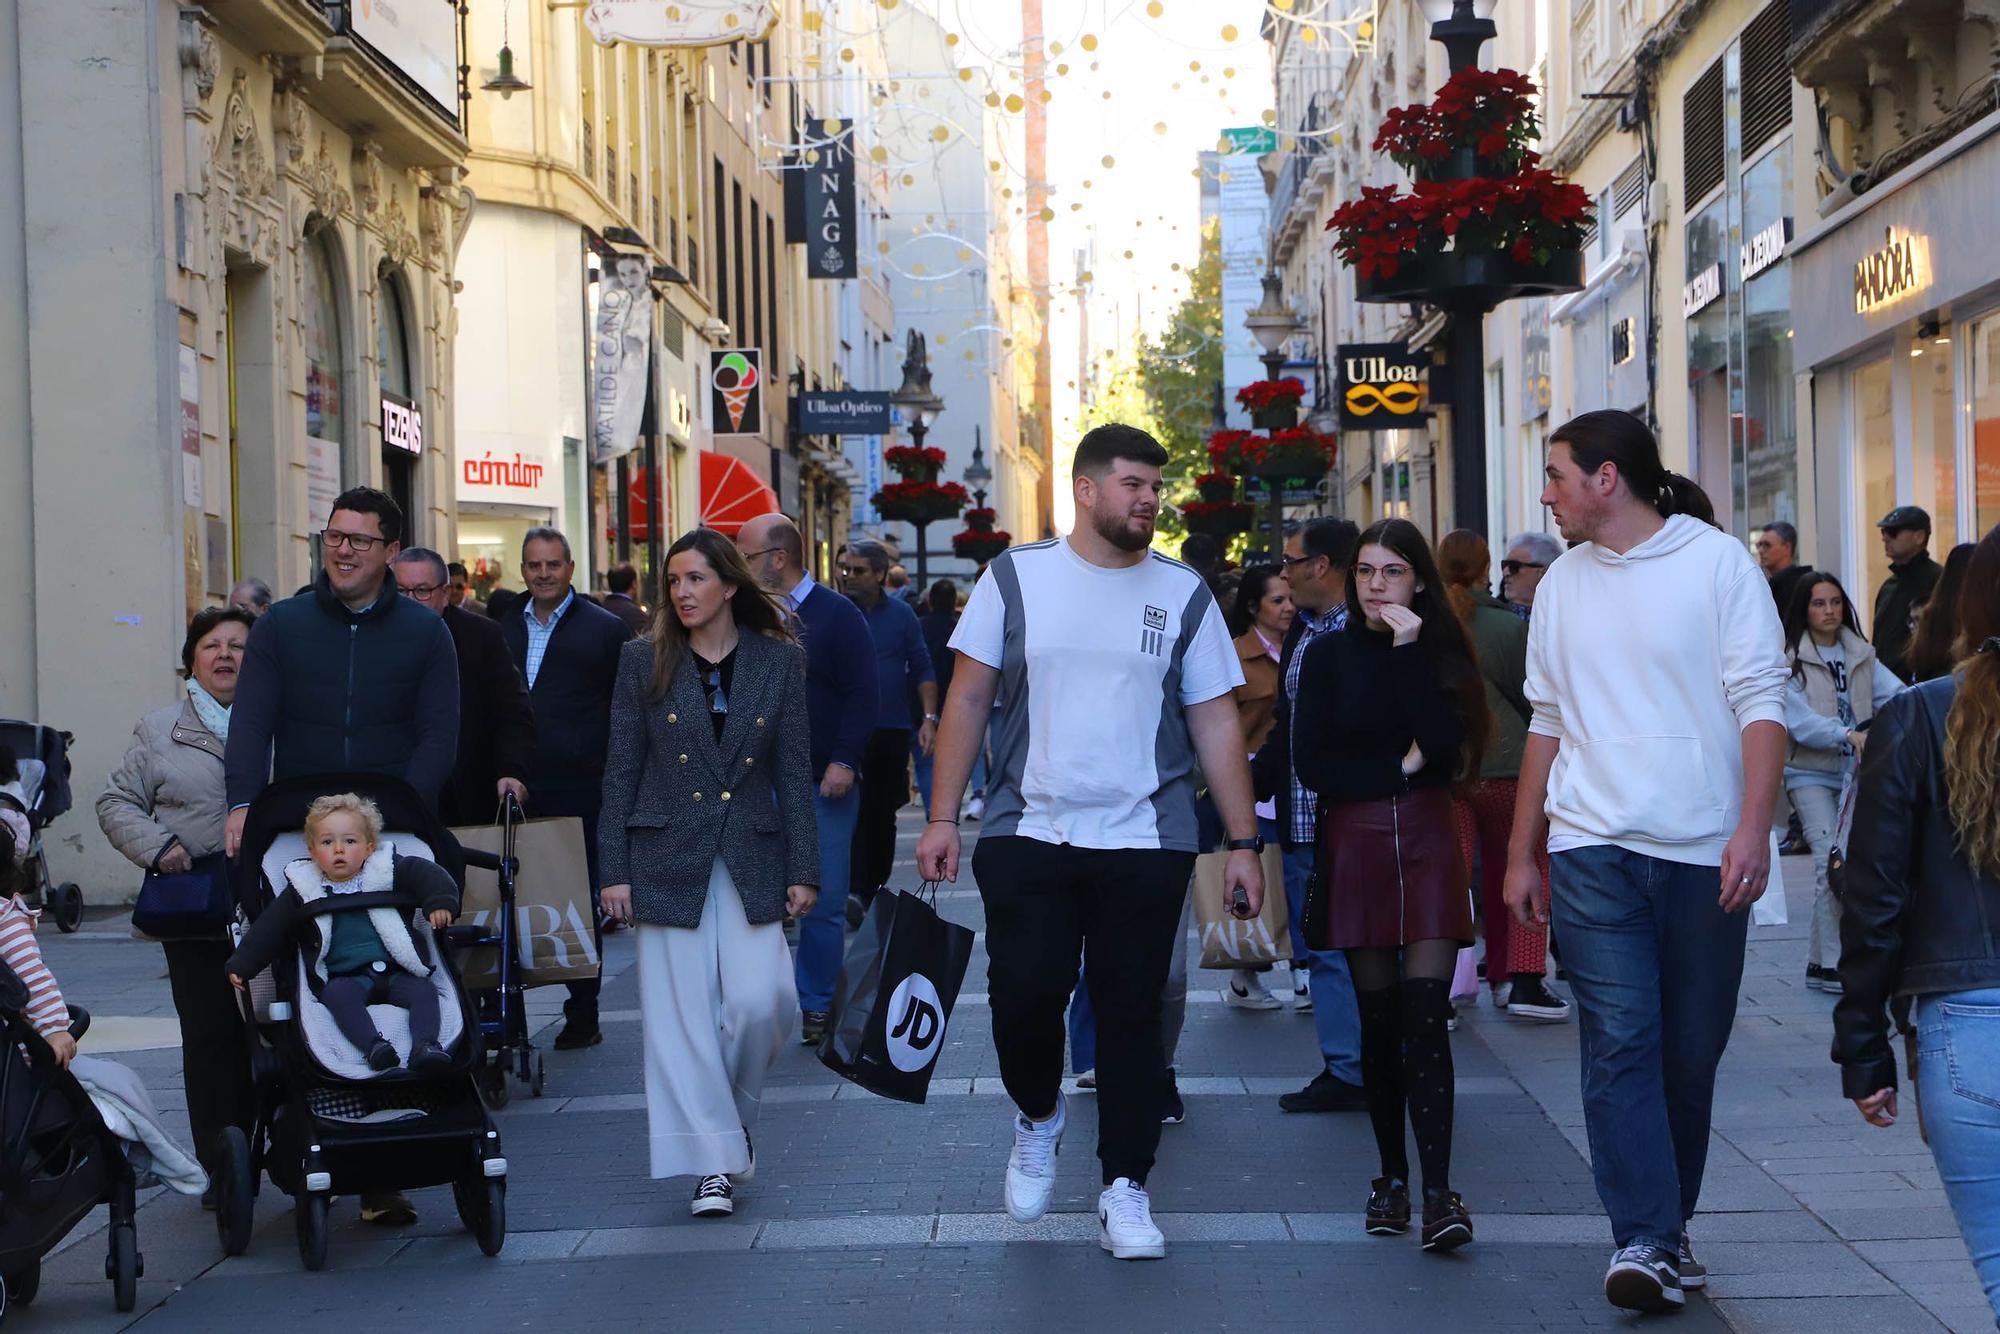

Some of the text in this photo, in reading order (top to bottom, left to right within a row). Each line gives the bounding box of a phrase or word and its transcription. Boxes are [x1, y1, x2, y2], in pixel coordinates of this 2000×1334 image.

[599, 291, 621, 449] MATILDE CANO
[1345, 357, 1418, 384] Ulloa
[807, 400, 883, 416] Ulloa Optico
[463, 450, 543, 488] cóndor
[891, 995, 939, 1050] JD
